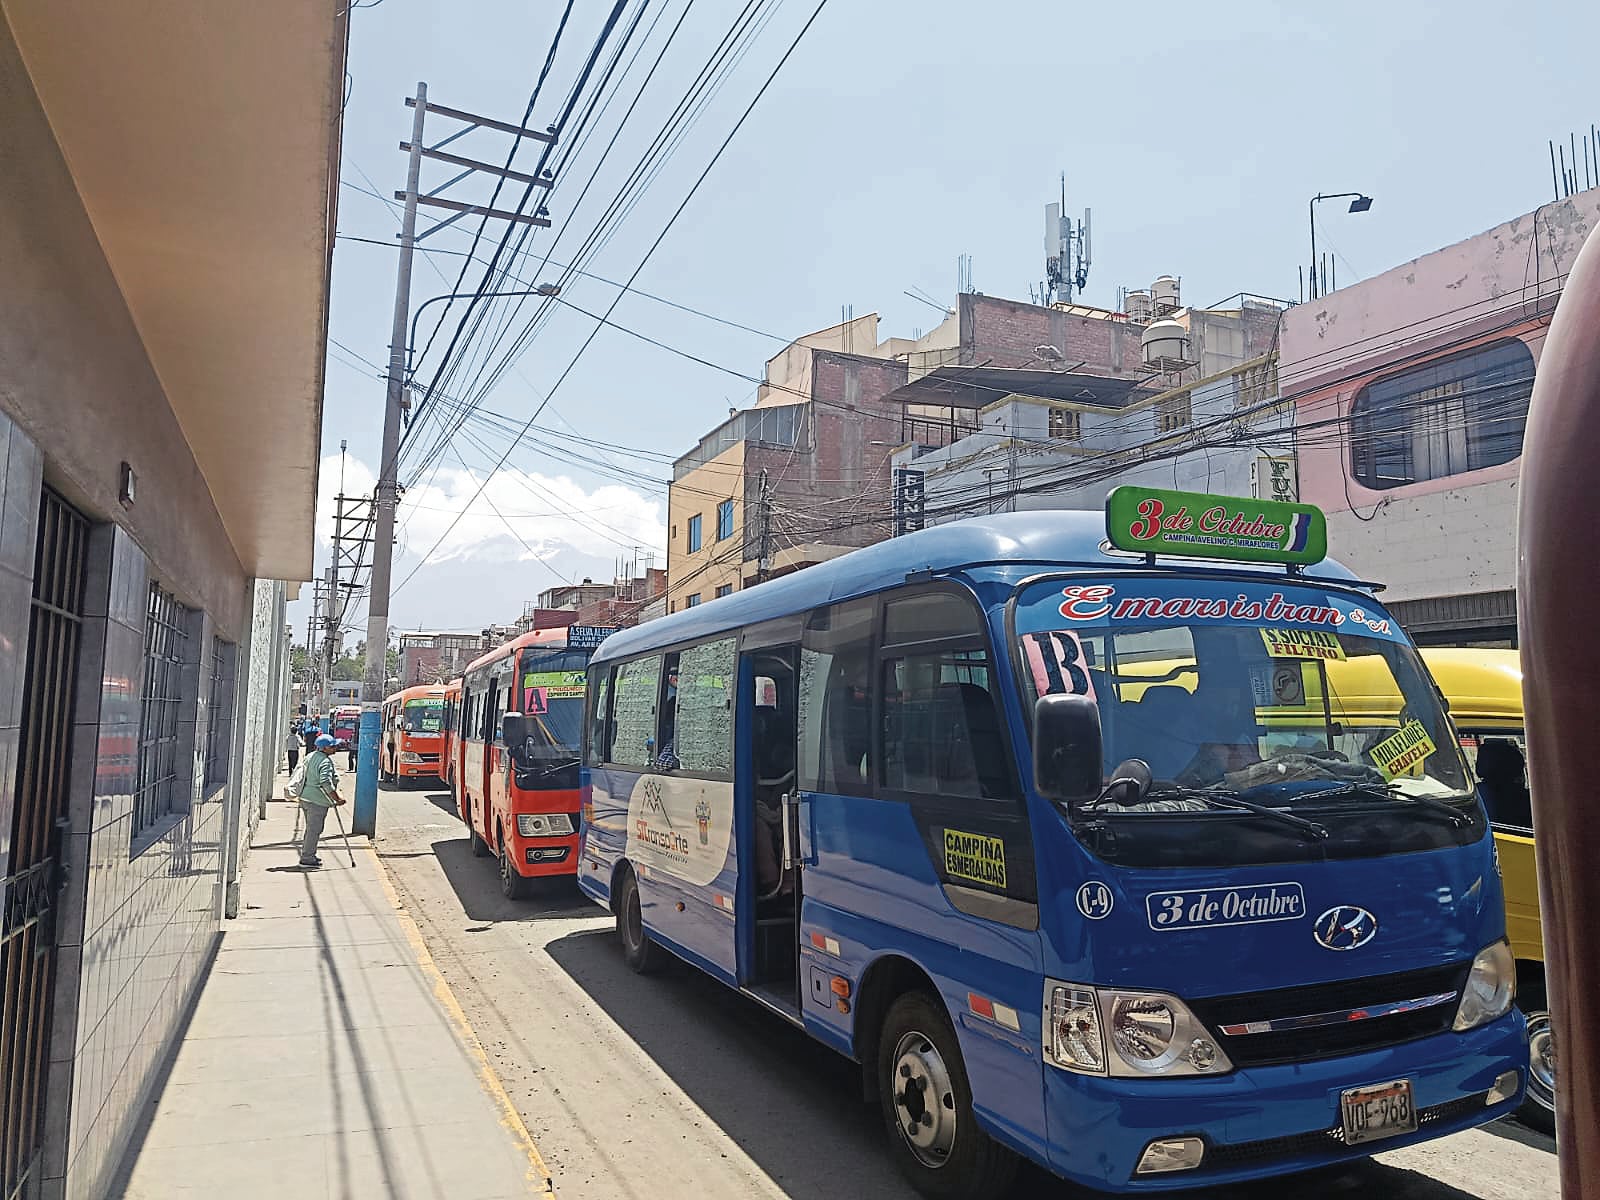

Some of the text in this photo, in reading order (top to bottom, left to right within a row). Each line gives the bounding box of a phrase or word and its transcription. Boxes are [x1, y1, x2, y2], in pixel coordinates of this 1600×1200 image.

[903, 474, 921, 533] FUNE
[1130, 498, 1286, 540] 3 de Octubre
[1197, 535, 1227, 546] AVELINO
[1237, 538, 1280, 550] MIRAFLORES
[1058, 584, 1393, 636] Emarsistran S.A.
[1033, 631, 1088, 695] B
[1272, 643, 1339, 660] FILTRO
[528, 688, 545, 712] A
[1372, 722, 1426, 767] MIRAFLORES
[1388, 741, 1430, 776] CHAVELA
[946, 852, 1005, 885] ESMERALDAS
[1081, 886, 1108, 915] C-9
[1156, 888, 1299, 924] 3 de Octubre
